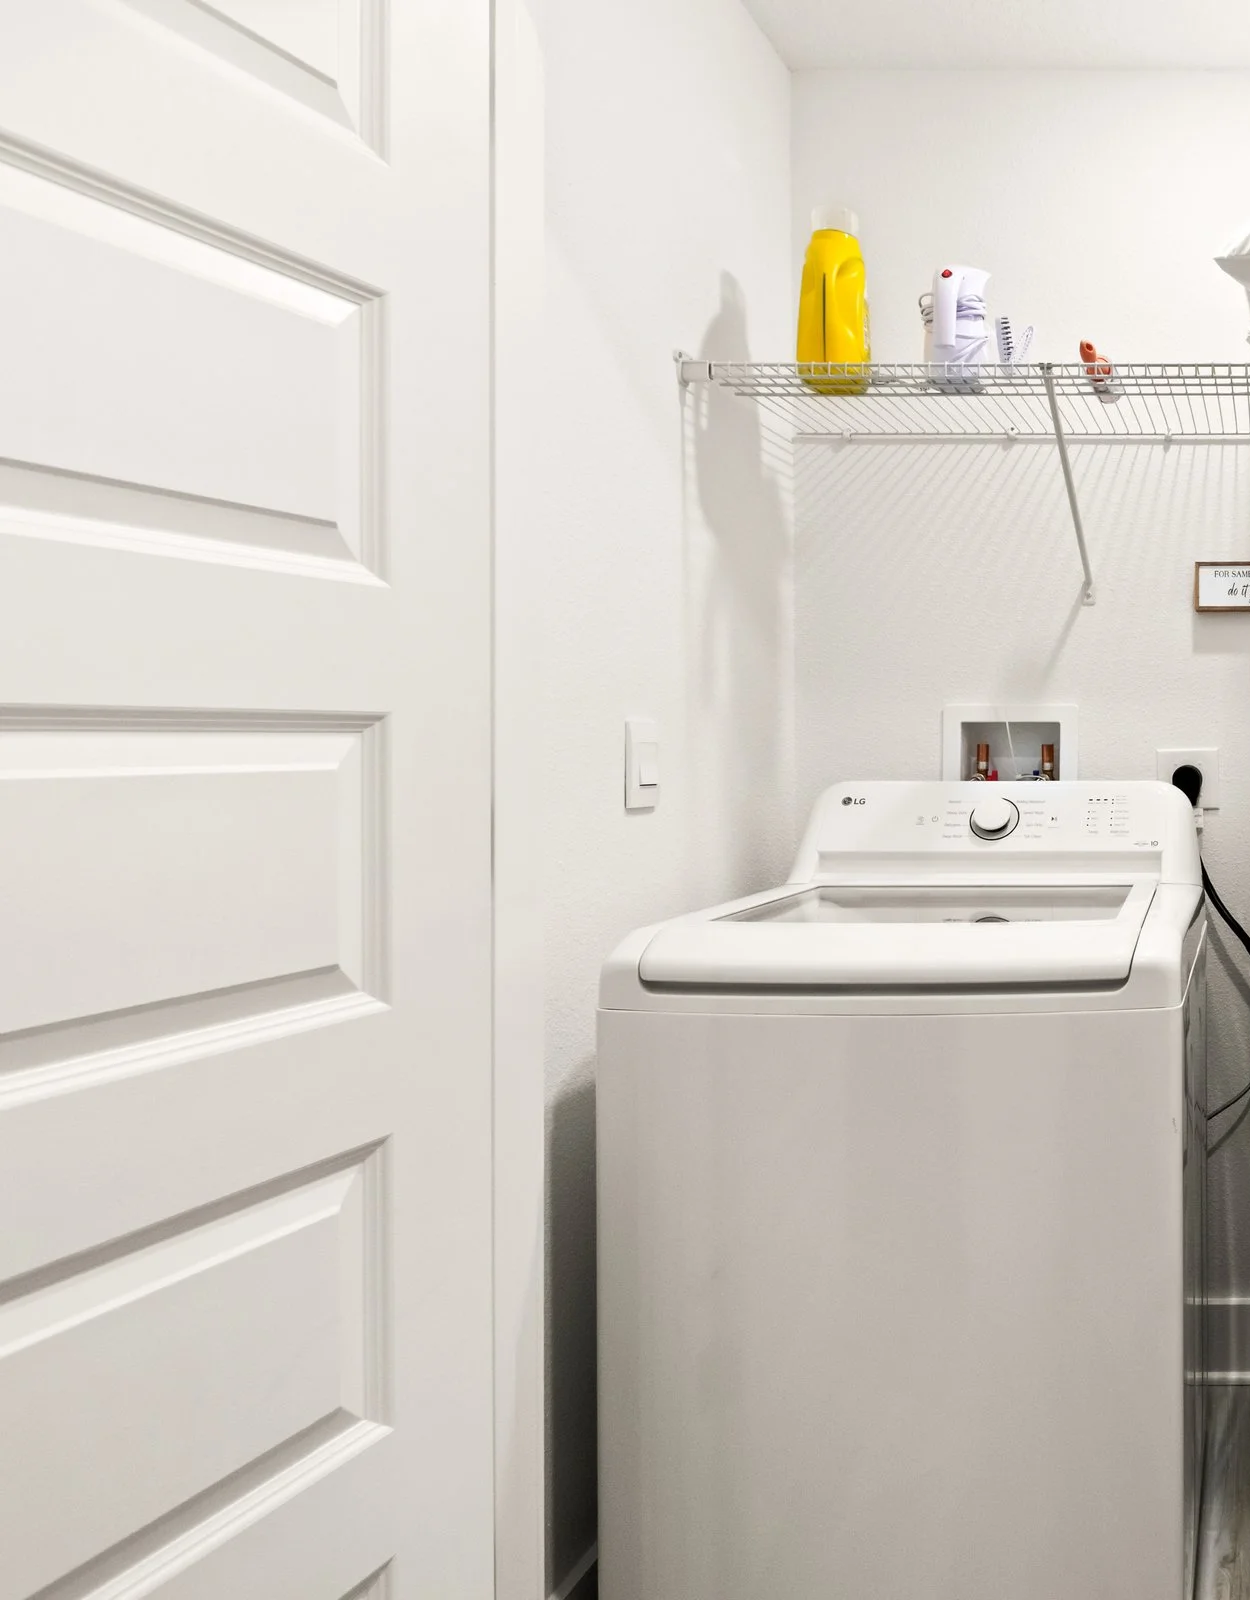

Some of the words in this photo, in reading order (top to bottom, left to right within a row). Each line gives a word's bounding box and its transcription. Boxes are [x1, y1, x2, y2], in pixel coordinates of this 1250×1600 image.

[1214, 570, 1230, 578] FOR
[1227, 582, 1238, 596] do
[1241, 583, 1250, 597] it
